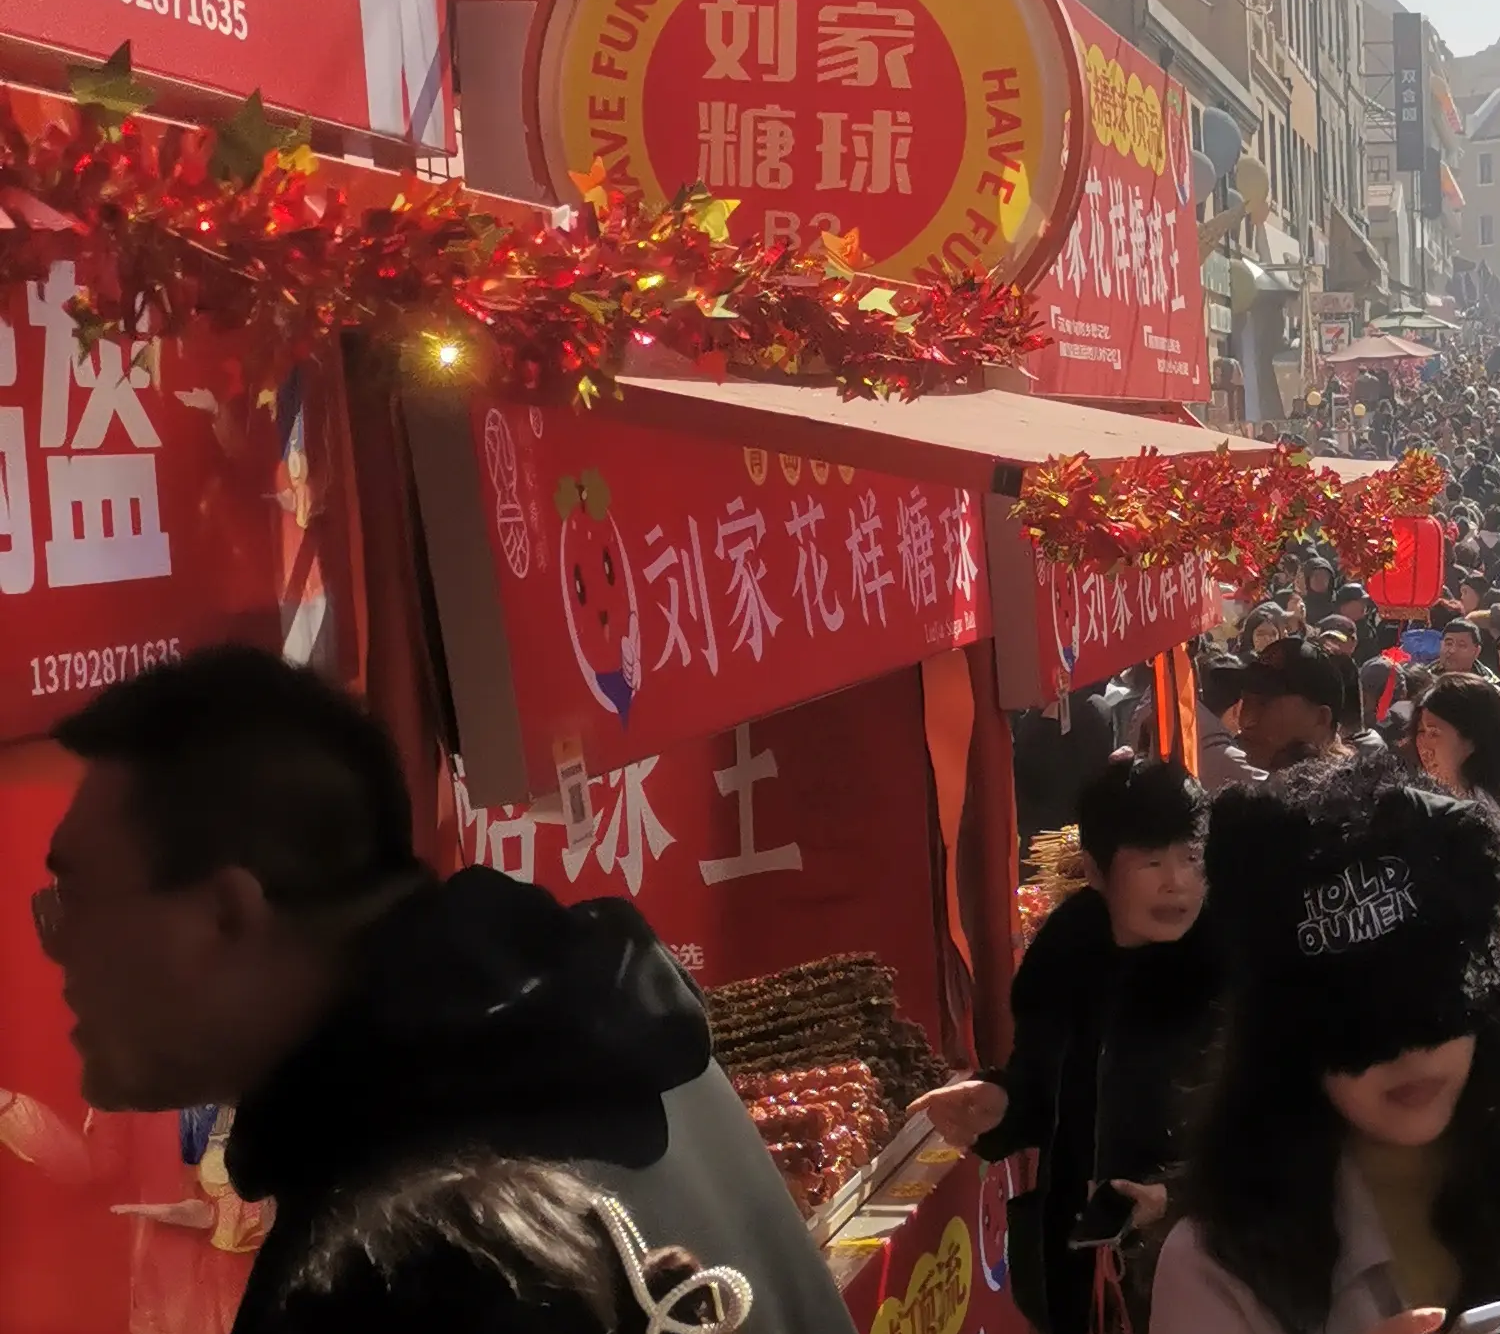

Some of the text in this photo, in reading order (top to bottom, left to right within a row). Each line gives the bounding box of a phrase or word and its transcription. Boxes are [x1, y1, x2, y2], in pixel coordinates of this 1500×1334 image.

[697, 101, 913, 195] 糖球
[977, 67, 1026, 205] HAVE
[1050, 165, 1186, 314] 家花样糖球王
[642, 485, 979, 677] 刘家花样糖球
